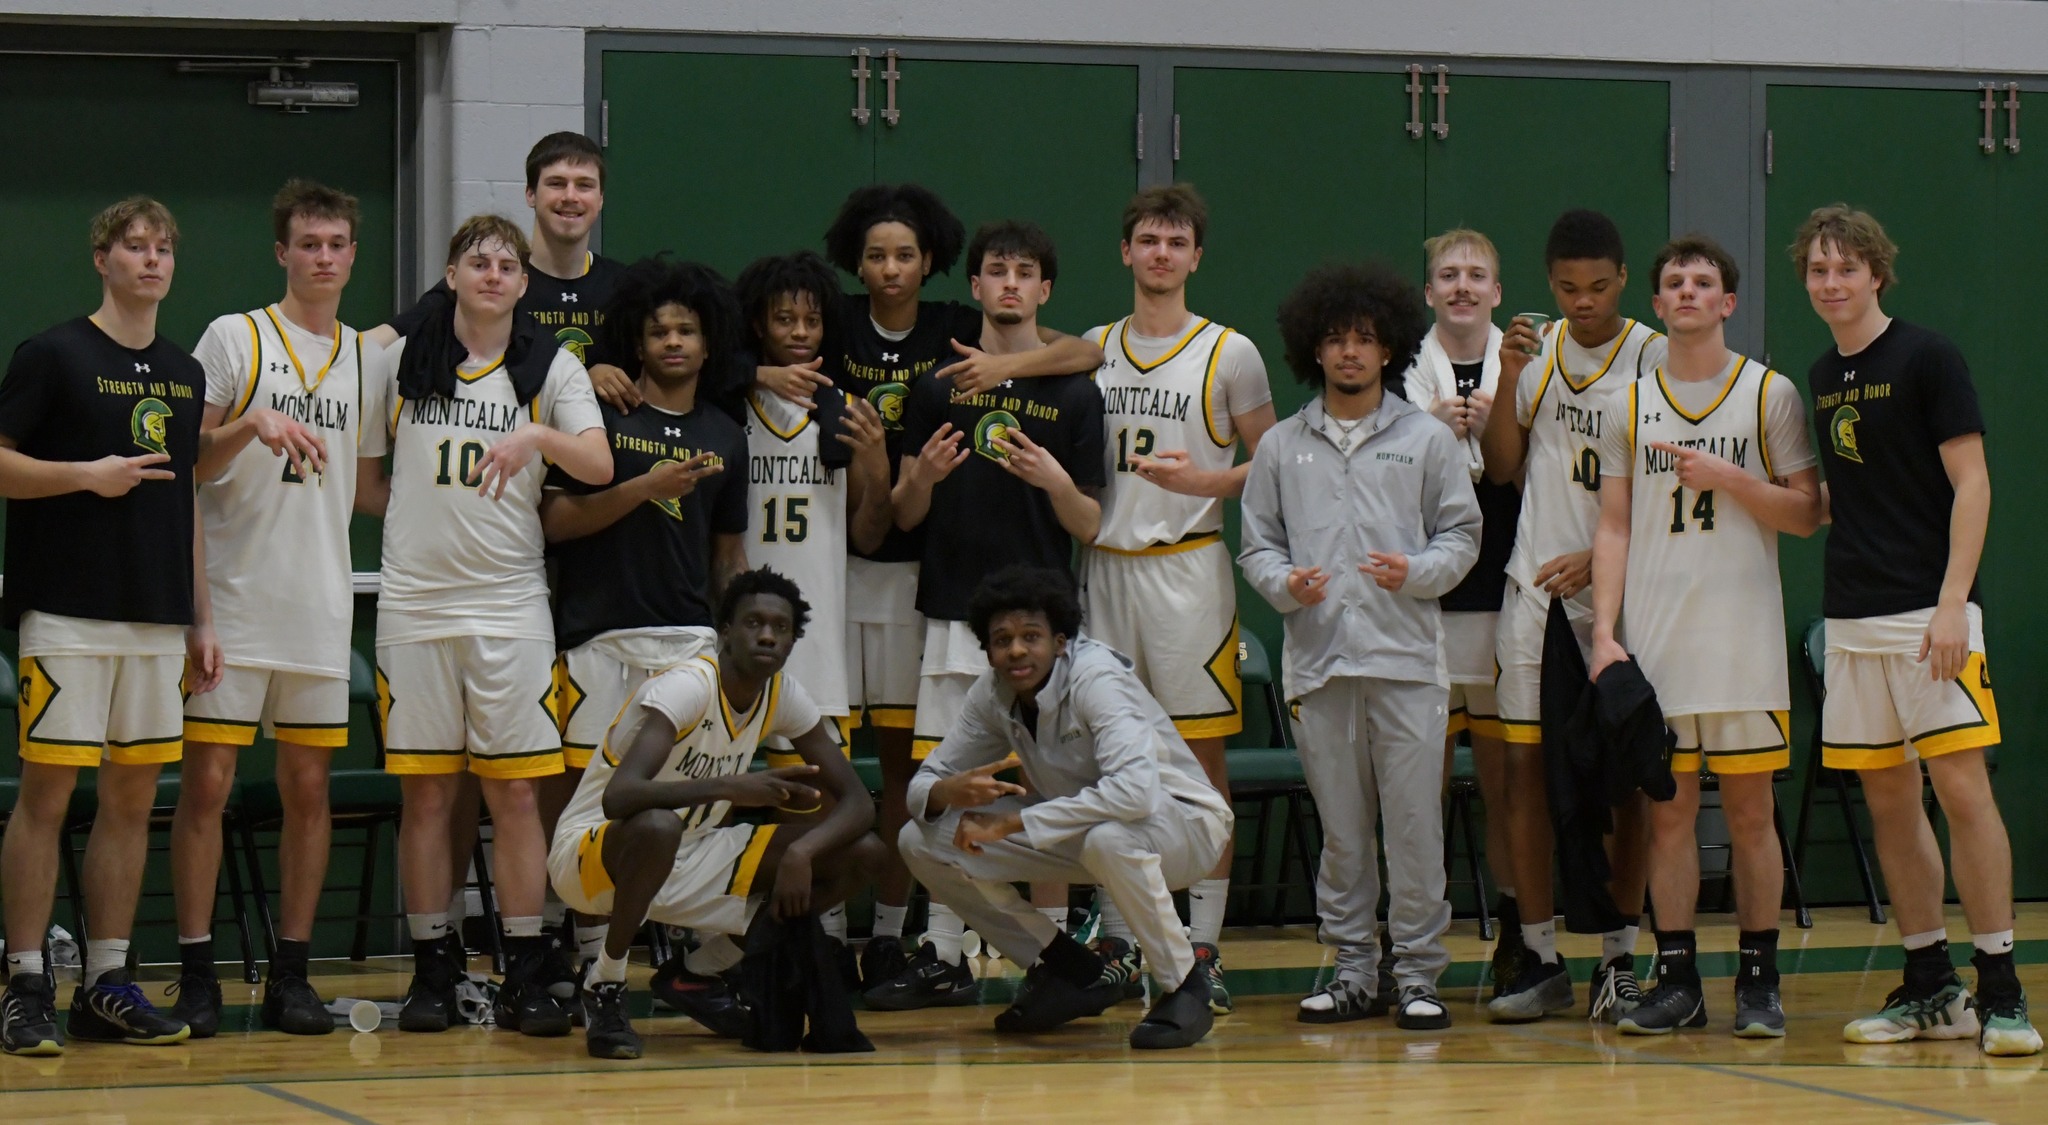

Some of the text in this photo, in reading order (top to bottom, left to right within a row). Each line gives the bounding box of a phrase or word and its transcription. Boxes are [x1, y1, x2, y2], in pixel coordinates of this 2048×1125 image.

[572, 312, 589, 325] AND
[97, 376, 193, 399] STRENGTH AND HONOR
[892, 369, 909, 382] AND
[1002, 396, 1021, 411] AND
[1026, 400, 1059, 421] HONOR
[1816, 383, 1891, 410] STRENGTH AND HONOR
[411, 396, 518, 432] MONTCALM
[616, 432, 666, 456] STRENGTH
[673, 446, 691, 462] AND
[1376, 452, 1414, 465] MONTCALM
[435, 437, 486, 490] 10
[749, 456, 835, 486] ONTCALM
[761, 494, 812, 545] 15
[1669, 483, 1716, 535] 14
